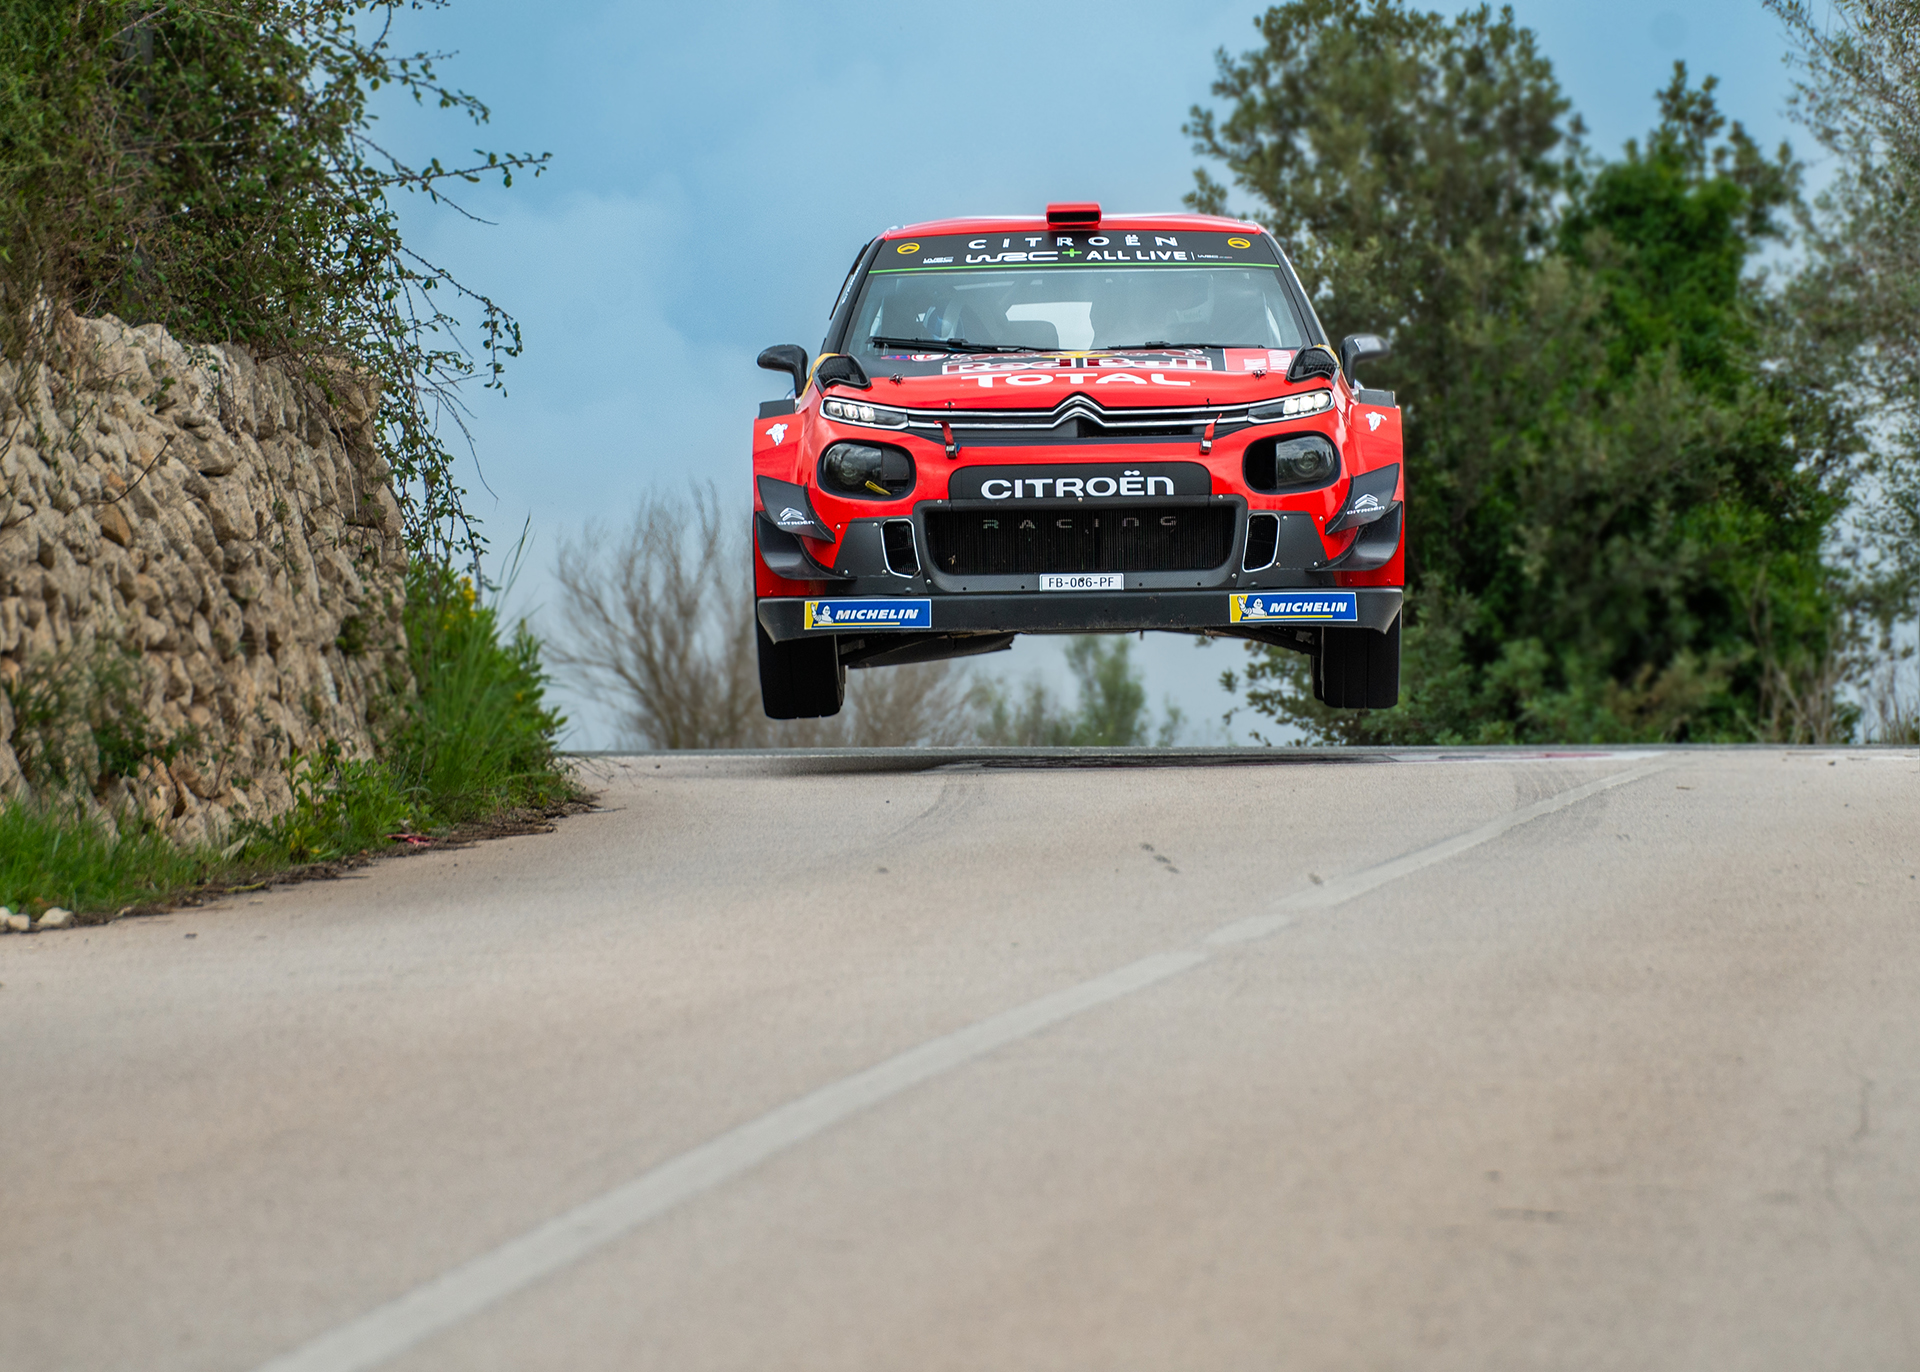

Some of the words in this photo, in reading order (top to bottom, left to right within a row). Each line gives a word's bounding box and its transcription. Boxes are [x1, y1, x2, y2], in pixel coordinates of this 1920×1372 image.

[968, 234, 1178, 250] CITROËN
[1086, 250, 1130, 261] ALL
[1135, 250, 1188, 261] LIVE
[941, 357, 1076, 376] Red
[1082, 357, 1213, 371] Bull
[960, 373, 1192, 388] TOTAL
[980, 470, 1176, 500] CITROËN
[1345, 505, 1386, 515] CITROËN
[982, 516, 1178, 530] RACING
[1269, 602, 1349, 613] MICHELIN
[835, 609, 919, 621] MICHELIN
